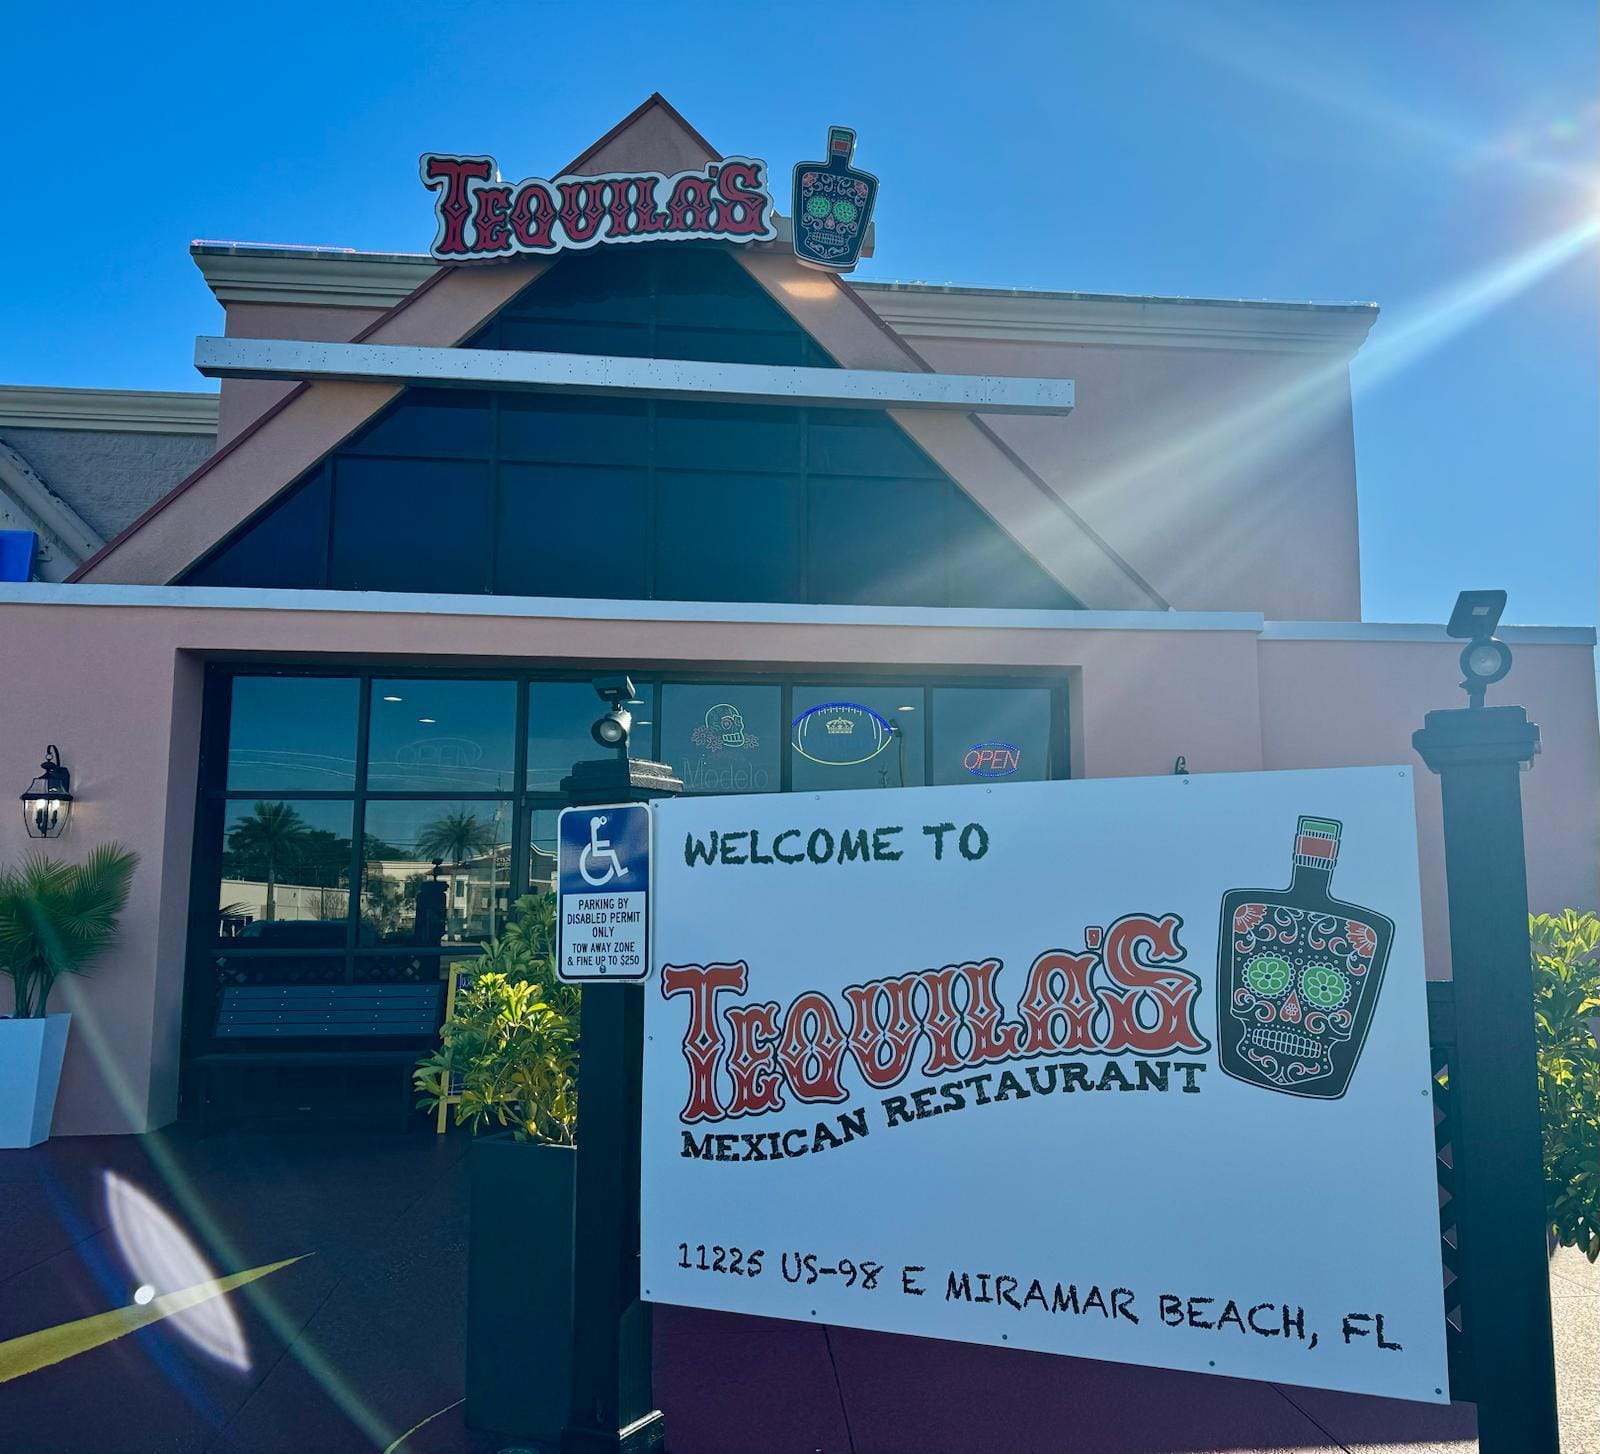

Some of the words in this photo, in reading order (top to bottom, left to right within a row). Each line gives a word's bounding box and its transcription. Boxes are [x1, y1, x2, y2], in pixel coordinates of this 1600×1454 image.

[964, 749, 1021, 769] OPEN
[683, 758, 768, 789] Modelo
[684, 826, 903, 867] WELCOME
[922, 822, 990, 861] TO
[578, 898, 615, 911] PARKING
[618, 897, 629, 909] BY
[567, 912, 607, 925] DISABLED
[610, 911, 641, 924] PERMIT
[592, 926, 615, 938] ONLY
[572, 943, 588, 954] TOW
[590, 942, 612, 953] AWAY
[614, 941, 636, 953] ZONE
[567, 956, 574, 967] &
[576, 955, 593, 966] FINE
[595, 955, 606, 966] UP
[608, 955, 618, 966] TO
[620, 954, 640, 967] $250
[680, 1107, 870, 1162] MEXICAN
[881, 1060, 1207, 1128] RESTAURANT
[678, 1242, 765, 1278] 11225
[781, 1251, 885, 1290] US-98
[901, 1265, 926, 1296] E
[945, 1270, 1141, 1326] MIRAMAR
[1159, 1292, 1318, 1350] BEACH,
[1342, 1311, 1403, 1352] FL
